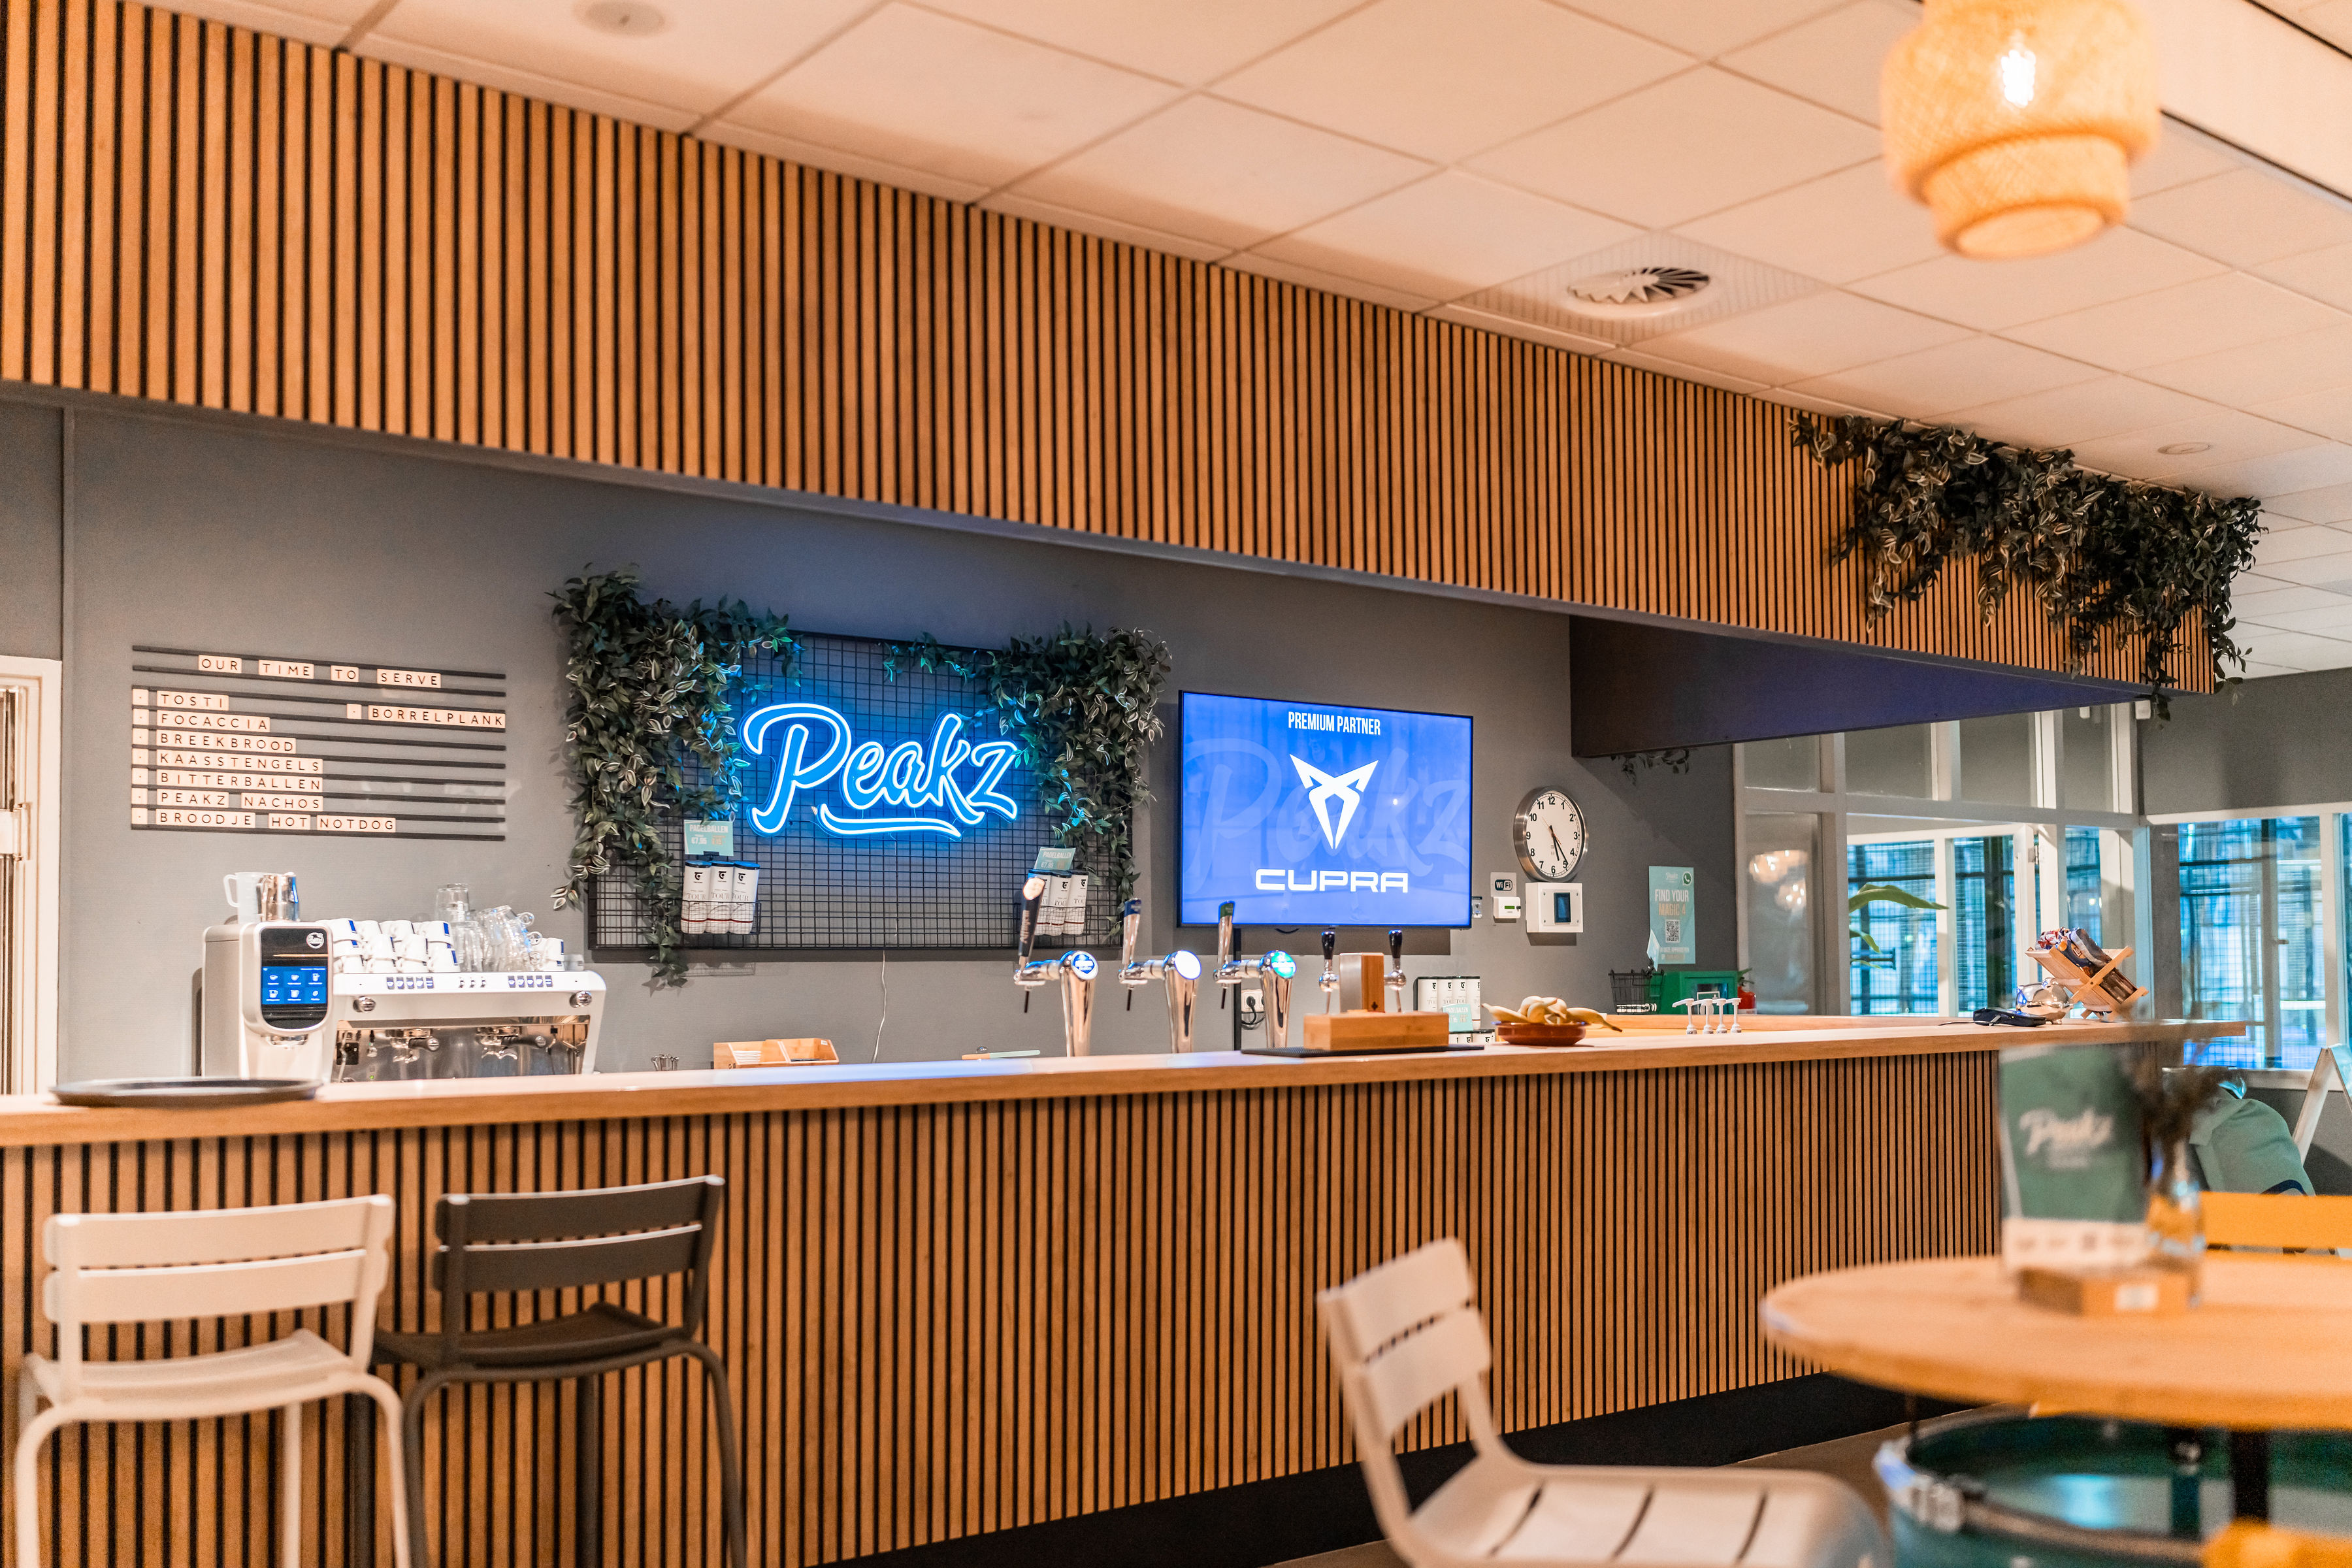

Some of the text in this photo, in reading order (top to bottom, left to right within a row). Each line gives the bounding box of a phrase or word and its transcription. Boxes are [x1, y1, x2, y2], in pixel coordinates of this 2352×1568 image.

[201, 658, 438, 685] OUR TIME TO SERVE
[161, 694, 223, 708] TOSTI
[161, 713, 267, 730] FOCACCIA
[372, 708, 503, 726] BORRELPLANK
[1288, 711, 1380, 736] PREMIUM PARTNER
[161, 732, 293, 751] BREEKBROOD
[161, 753, 319, 772] KAASSTENGELS
[743, 703, 1018, 836] Peakz
[161, 772, 320, 790] BITTERBALLEN
[161, 792, 319, 809] PEAKZ NACHOS
[1537, 801, 1544, 809] 11
[1548, 796, 1556, 805] 12
[160, 812, 393, 830] BROODJE HOT NOTDOG
[1529, 813, 1537, 821] 10
[1569, 813, 1575, 822] 2
[689, 825, 728, 833] PADELBALLEN
[1530, 848, 1535, 857] 8
[1539, 860, 1544, 869] 7
[1563, 860, 1568, 869] 5
[1256, 869, 1408, 893] CUPRA
[1655, 889, 1689, 902] FIND YOUR
[1659, 903, 1686, 915] MAGIC 4
